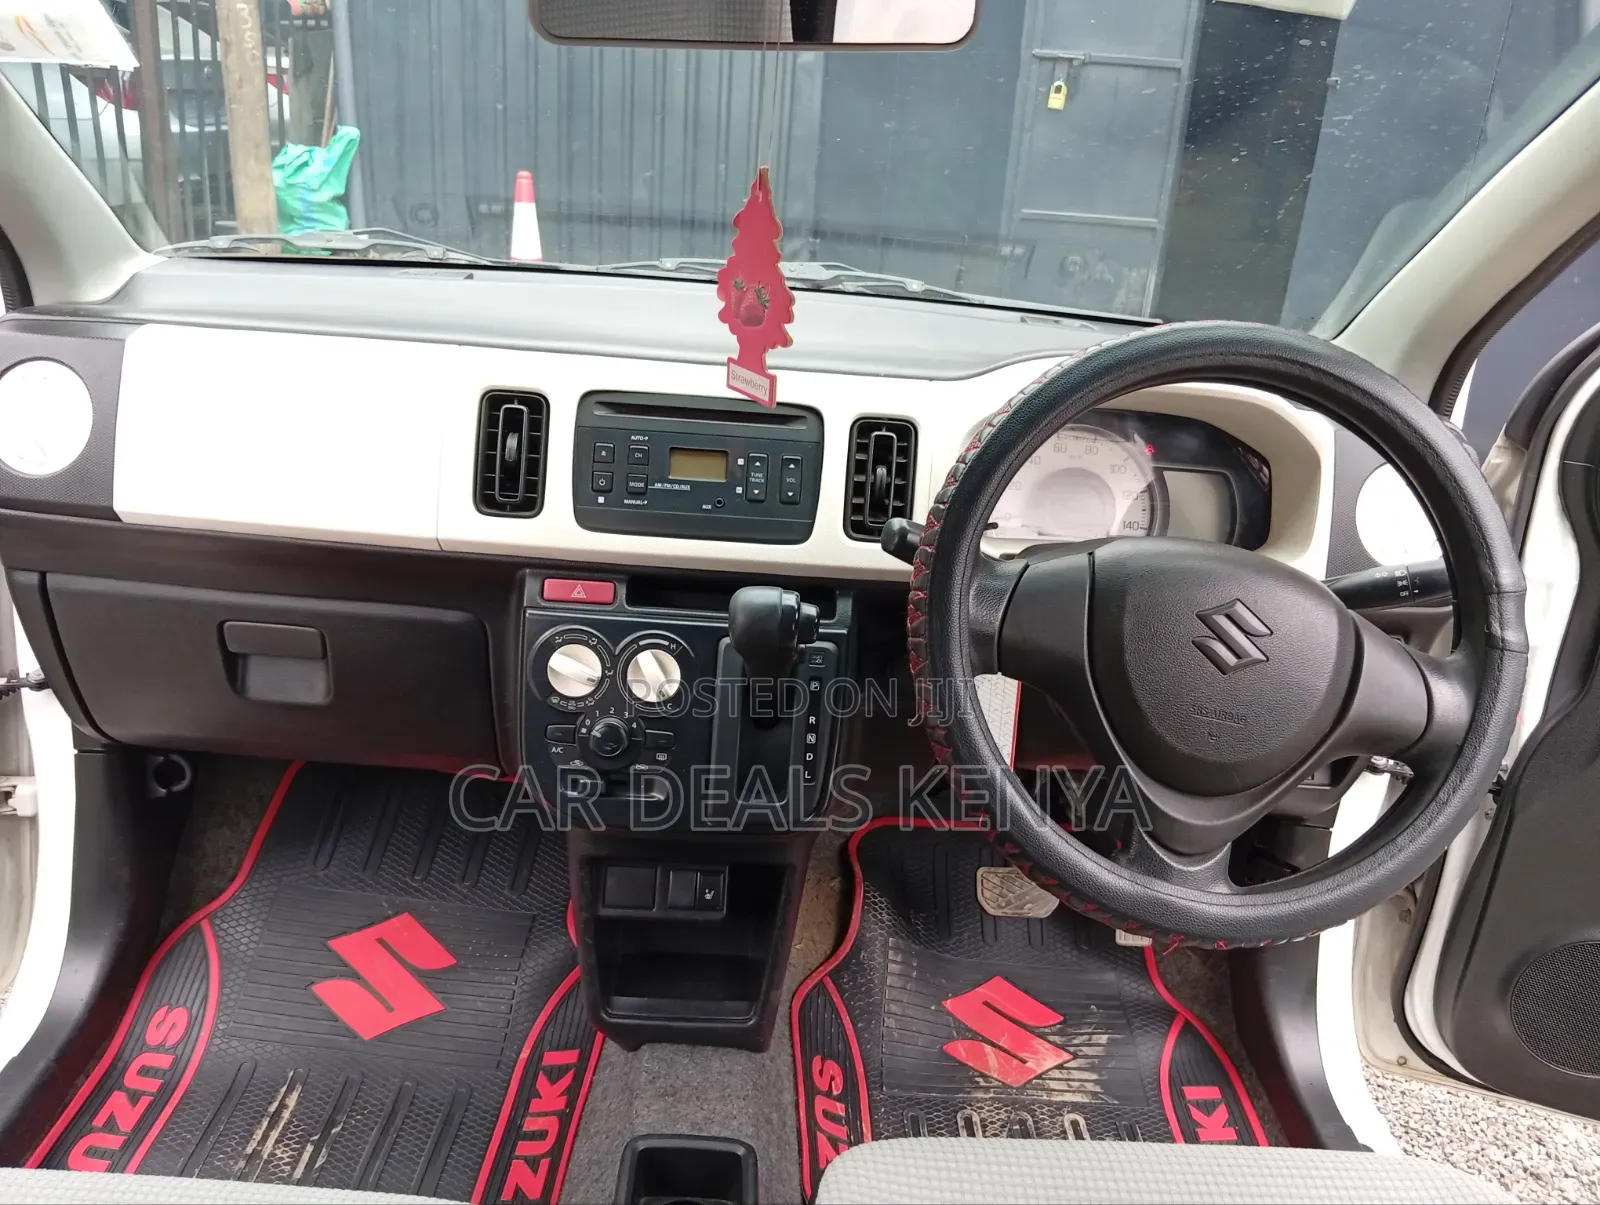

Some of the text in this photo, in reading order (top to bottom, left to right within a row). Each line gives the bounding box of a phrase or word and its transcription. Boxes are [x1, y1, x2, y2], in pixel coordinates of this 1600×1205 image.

[731, 370, 768, 396] Strawberry
[1053, 443, 1067, 453] 60
[1084, 445, 1099, 455] 80
[1109, 464, 1127, 475] 100
[1122, 520, 1140, 531] 140
[810, 681, 820, 691] P
[623, 711, 629, 719] 3
[809, 716, 816, 725] R
[806, 753, 813, 761] D
[804, 771, 812, 779] L
